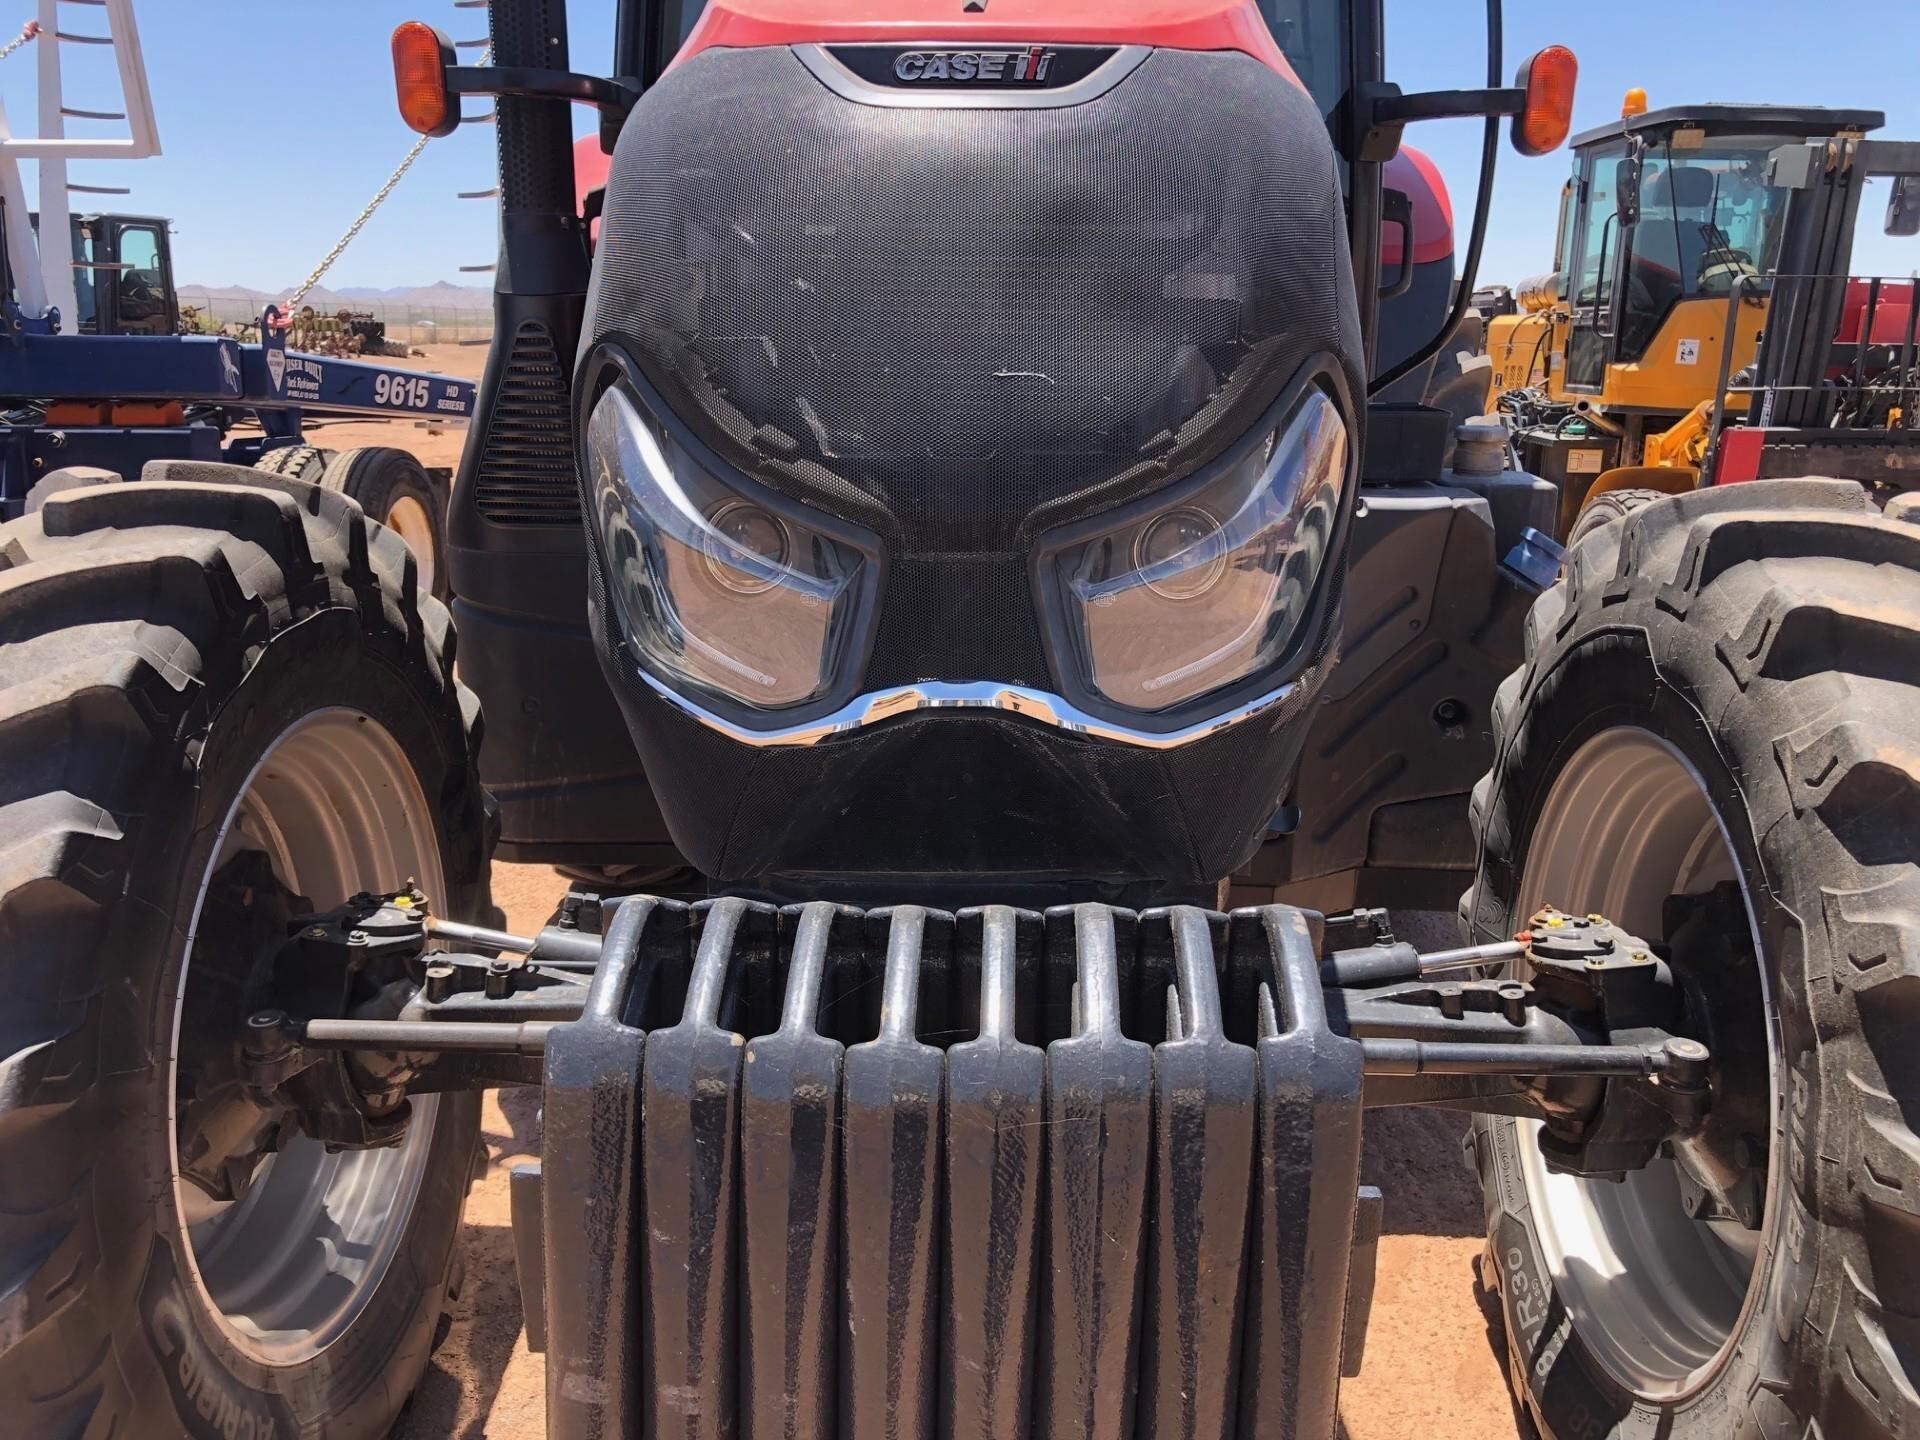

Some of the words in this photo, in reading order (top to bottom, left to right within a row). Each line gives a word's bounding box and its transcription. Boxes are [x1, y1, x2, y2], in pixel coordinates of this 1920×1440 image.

[894, 52, 1009, 81] CASE
[374, 373, 430, 408] 9615
[445, 384, 459, 398] HD
